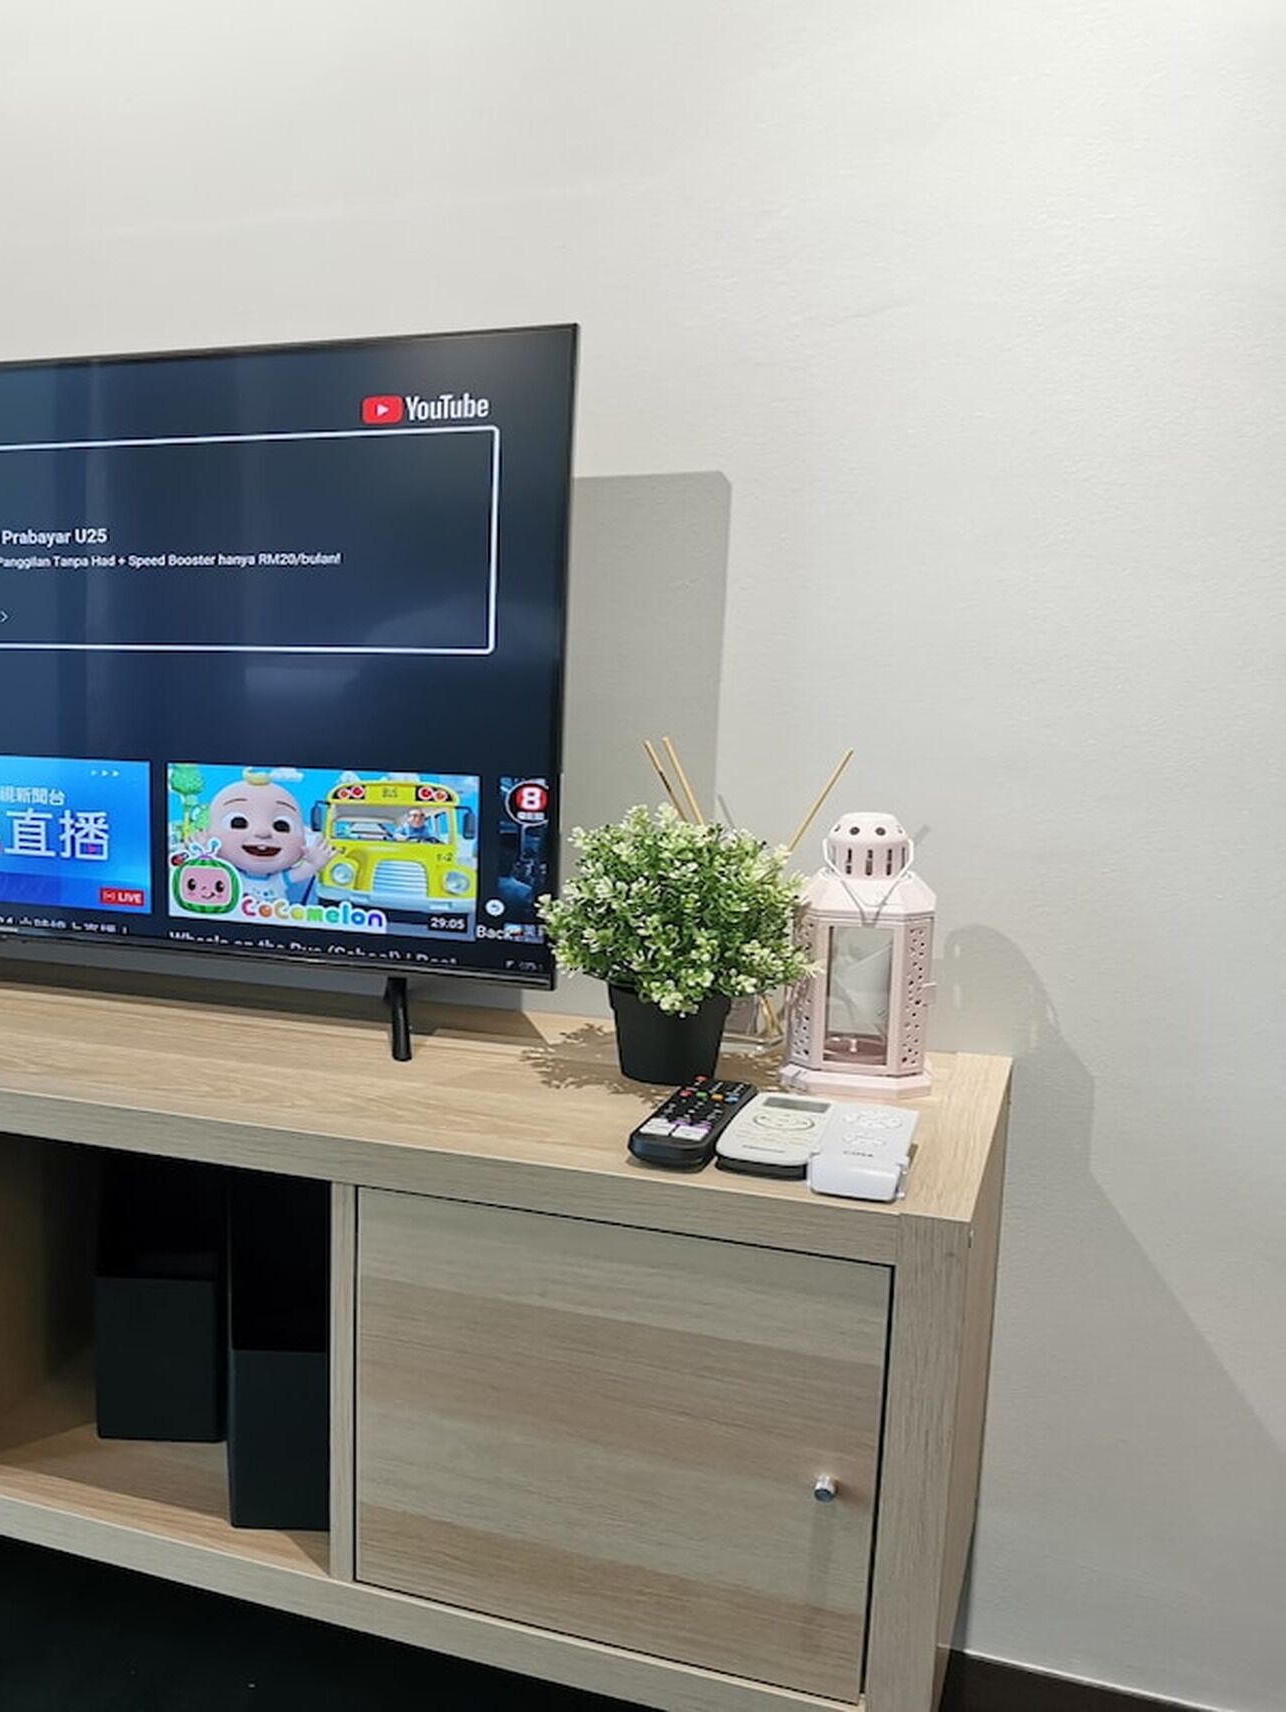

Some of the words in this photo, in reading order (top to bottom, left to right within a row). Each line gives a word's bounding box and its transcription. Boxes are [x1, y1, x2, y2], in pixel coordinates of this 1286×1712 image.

[405, 392, 489, 421] YouTube
[1, 529, 71, 548] Prabayar
[74, 528, 108, 544] U25
[53, 556, 89, 569] Tanpa
[91, 555, 116, 567] Had
[128, 554, 165, 568] Speed
[168, 554, 216, 567] Booster
[217, 553, 255, 568] hanya
[521, 786, 542, 811] 8
[4, 808, 110, 861] 直播
[117, 893, 143, 905] LIVE
[429, 916, 466, 930] 29:05
[476, 924, 513, 941] Back
